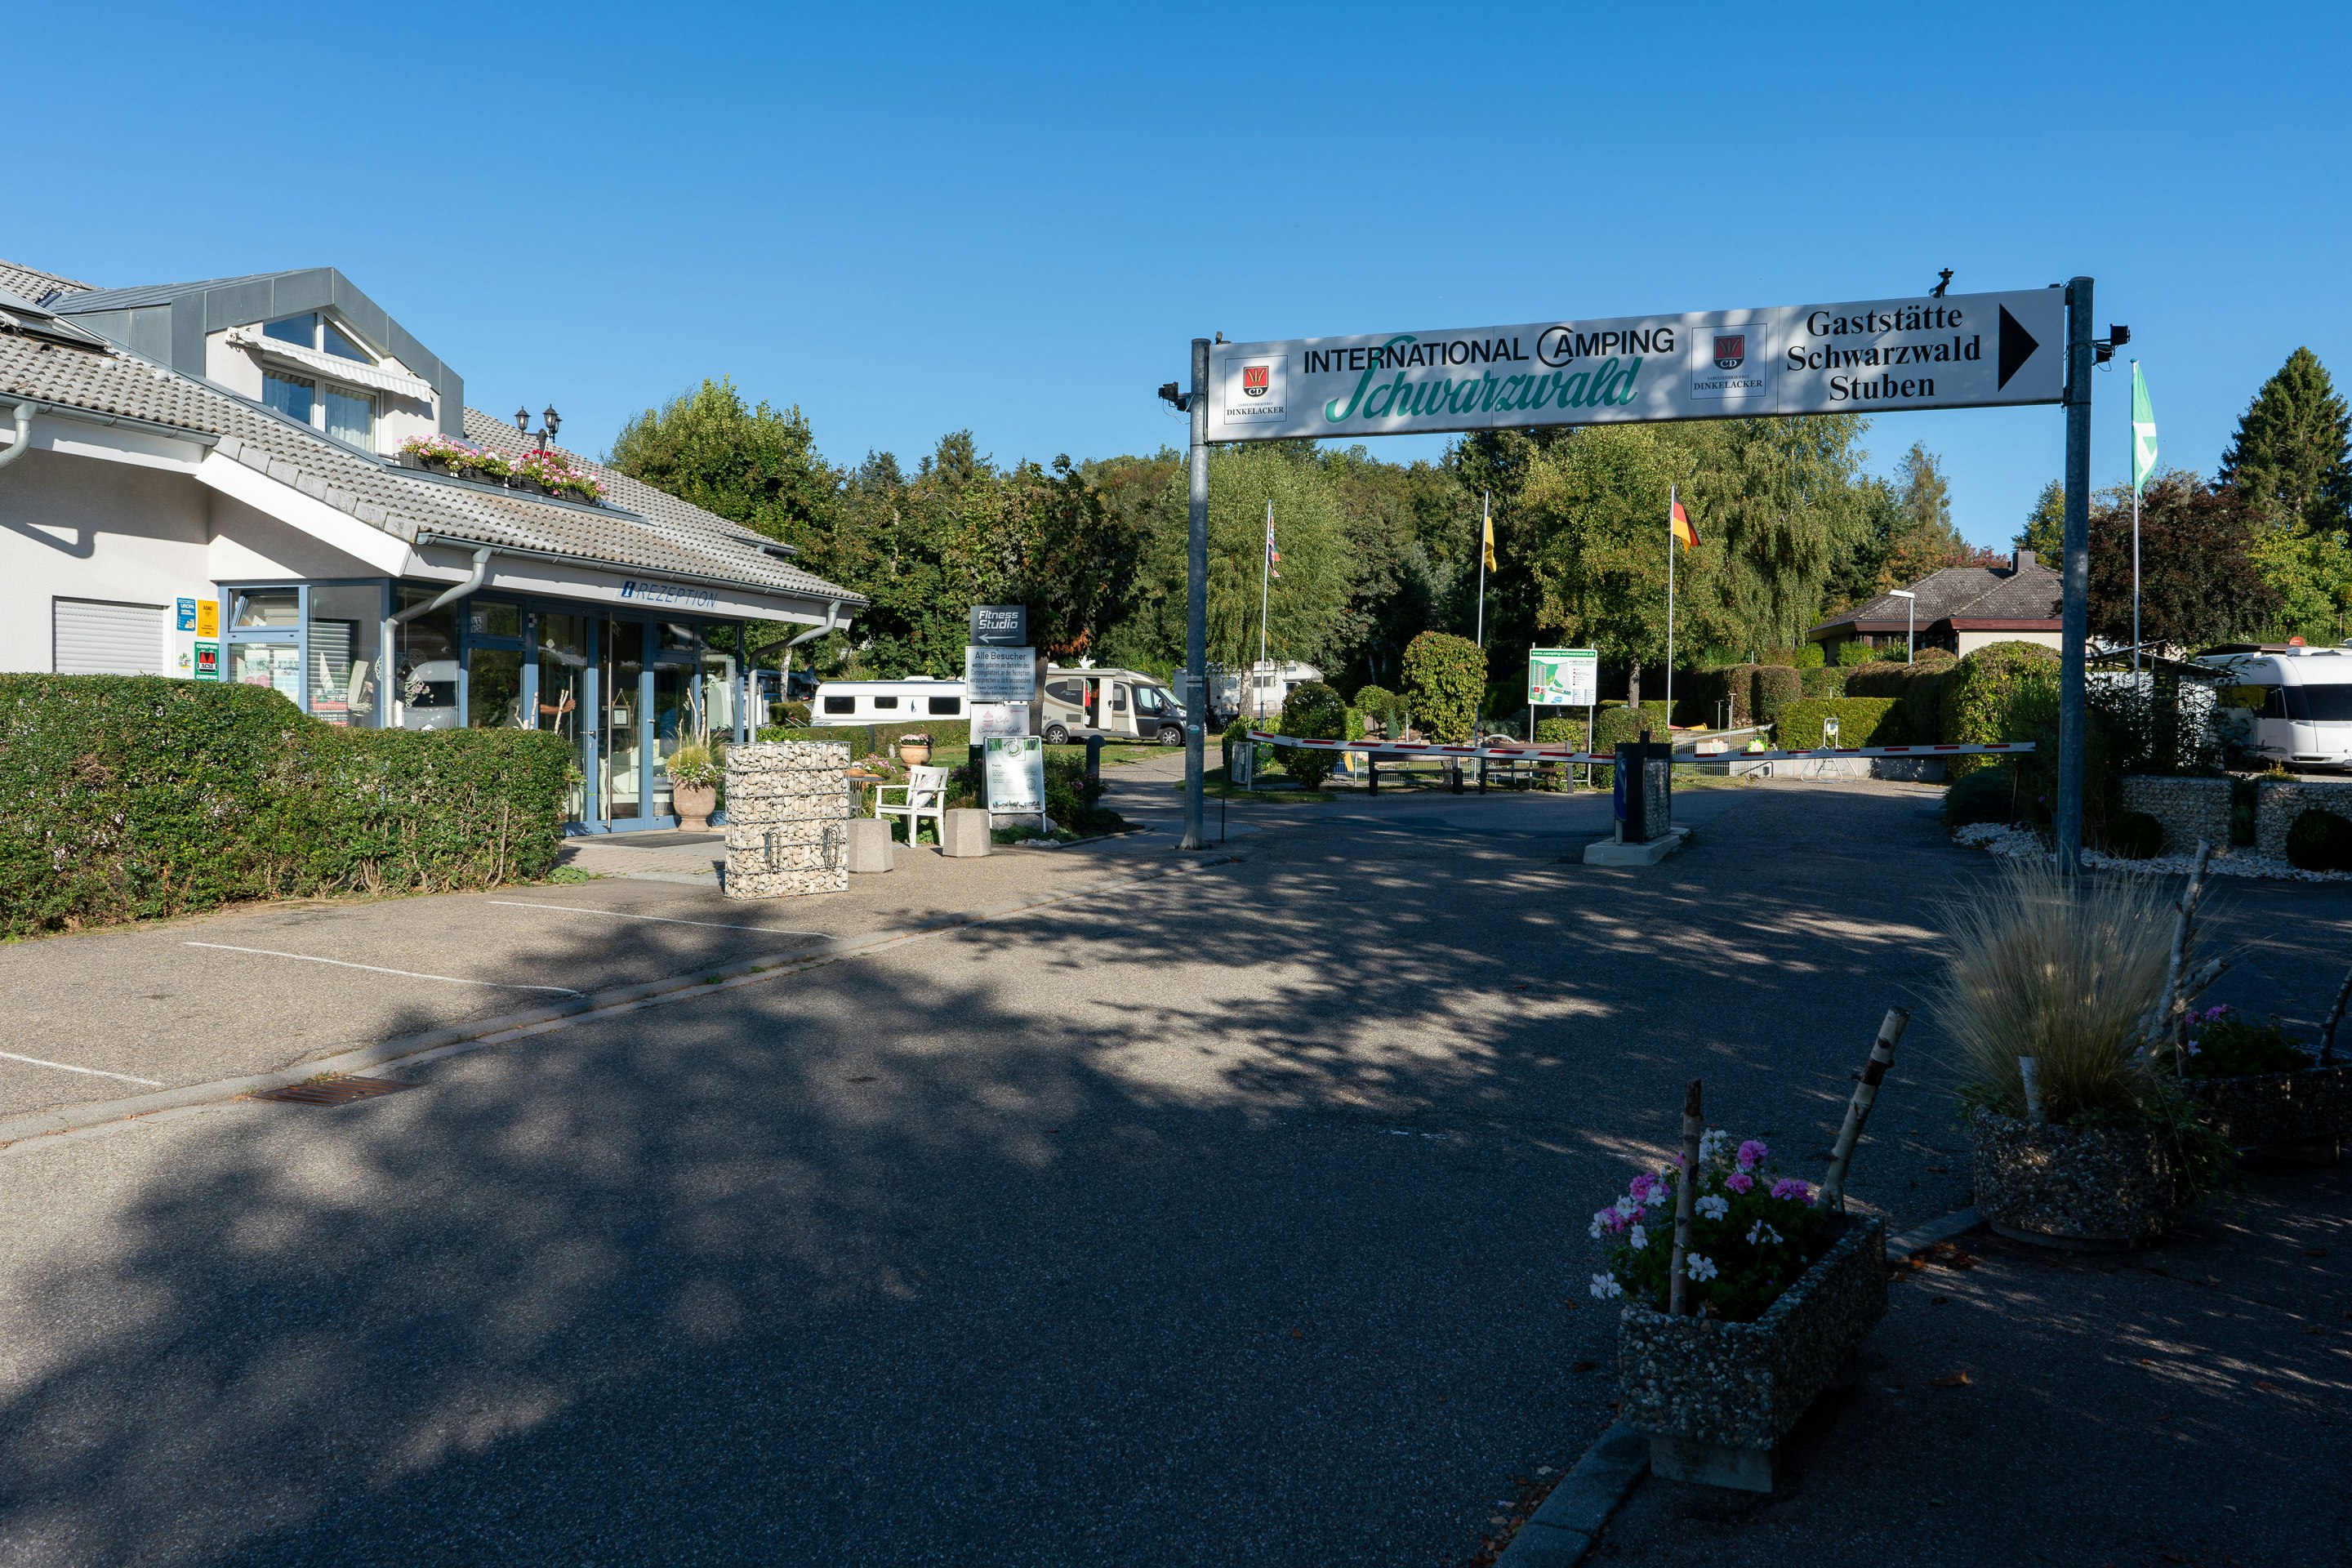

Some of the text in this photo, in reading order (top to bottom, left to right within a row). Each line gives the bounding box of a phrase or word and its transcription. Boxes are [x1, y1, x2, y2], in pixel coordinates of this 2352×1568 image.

[1806, 305, 1963, 338] Gaststätte
[1304, 326, 1674, 374] INTERNATIONAL CAMPING
[1786, 334, 1982, 372] Schwarzwald
[1720, 359, 1738, 368] CD
[1325, 335, 1645, 423] Schwarzwald
[1694, 380, 1763, 390] DINKELACKER
[1829, 373, 1936, 403] Stuben
[1248, 387, 1263, 396] CD
[1227, 406, 1285, 416] DINKELACKER
[635, 582, 719, 608] REZEPTION
[978, 610, 1019, 619] Fitness
[978, 619, 1018, 629] Studio
[974, 651, 1027, 660] Alle Besucher
[978, 726, 1004, 735] Camping
